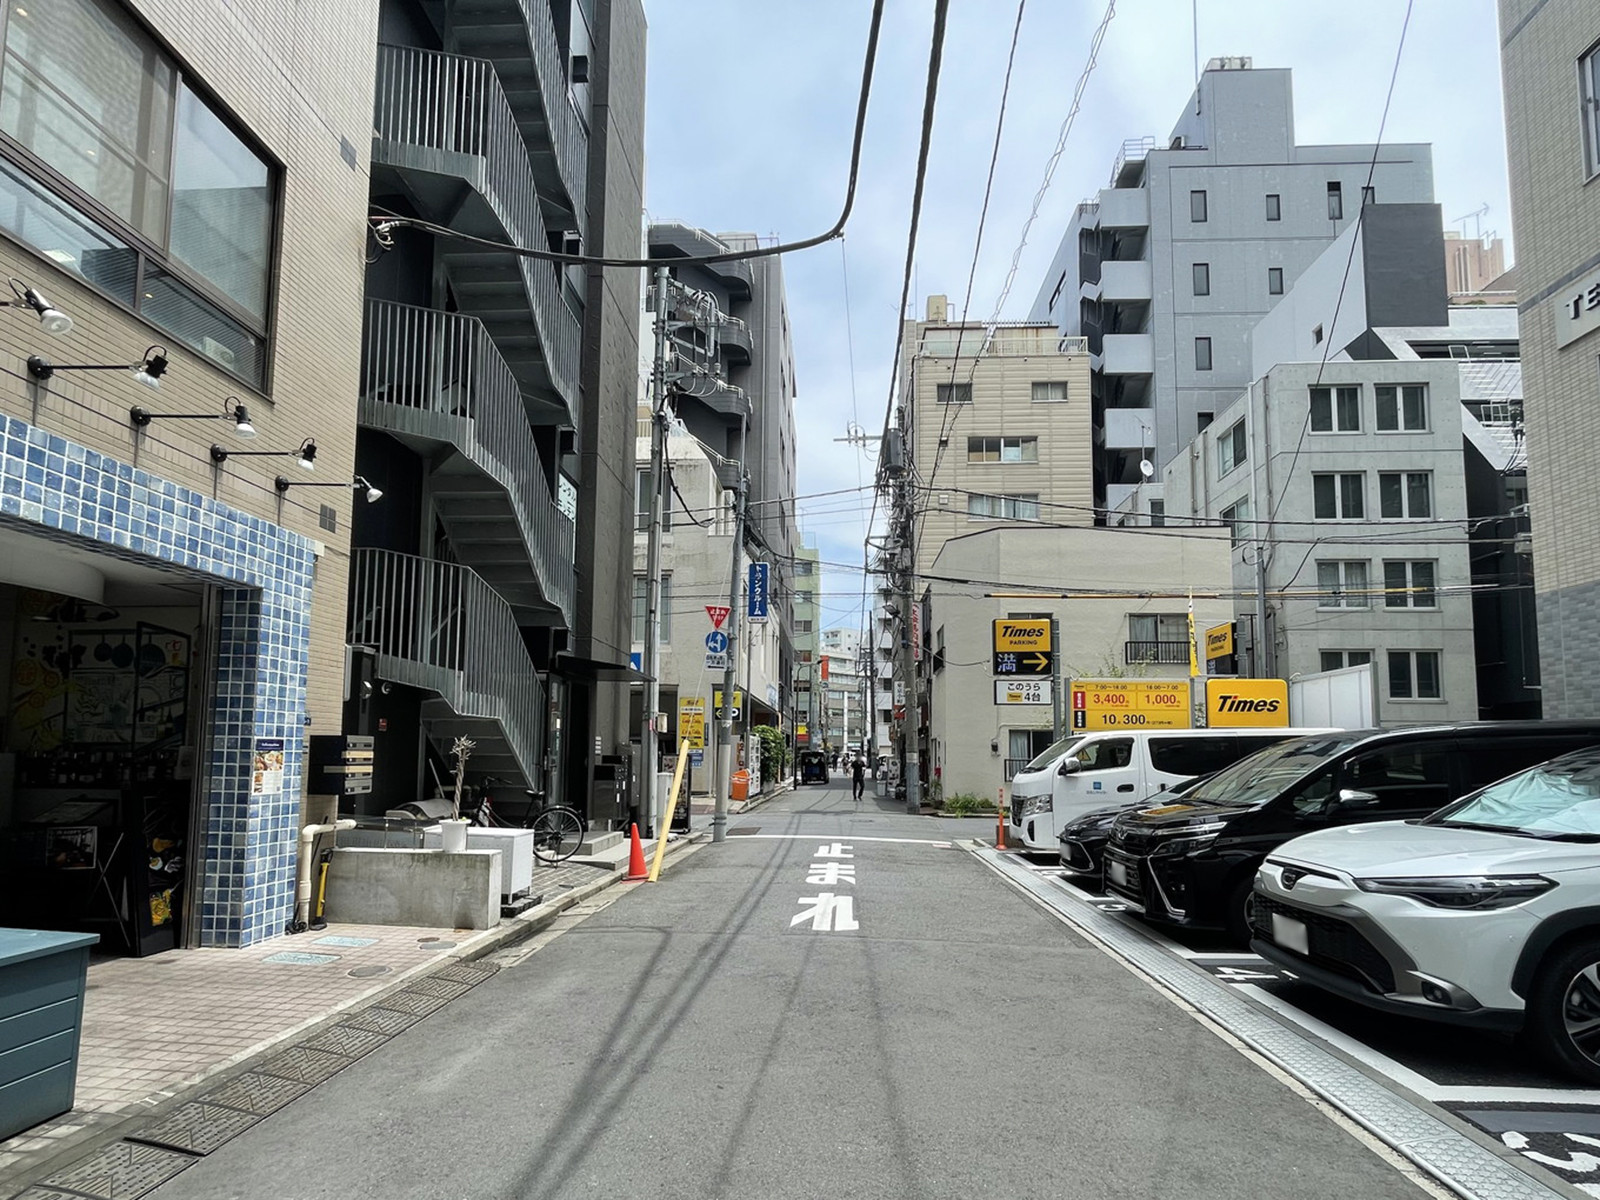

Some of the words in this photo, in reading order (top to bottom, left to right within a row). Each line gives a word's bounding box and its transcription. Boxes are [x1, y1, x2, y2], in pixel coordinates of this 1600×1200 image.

[754, 564, 763, 615] トランクルーム
[1002, 625, 1045, 638] Times
[1207, 632, 1228, 646] Times
[997, 653, 1017, 672] 満
[1007, 683, 1041, 691] このうら
[1024, 692, 1041, 702] 4台
[1218, 695, 1280, 712] Times
[790, 842, 859, 931] 止まれ
